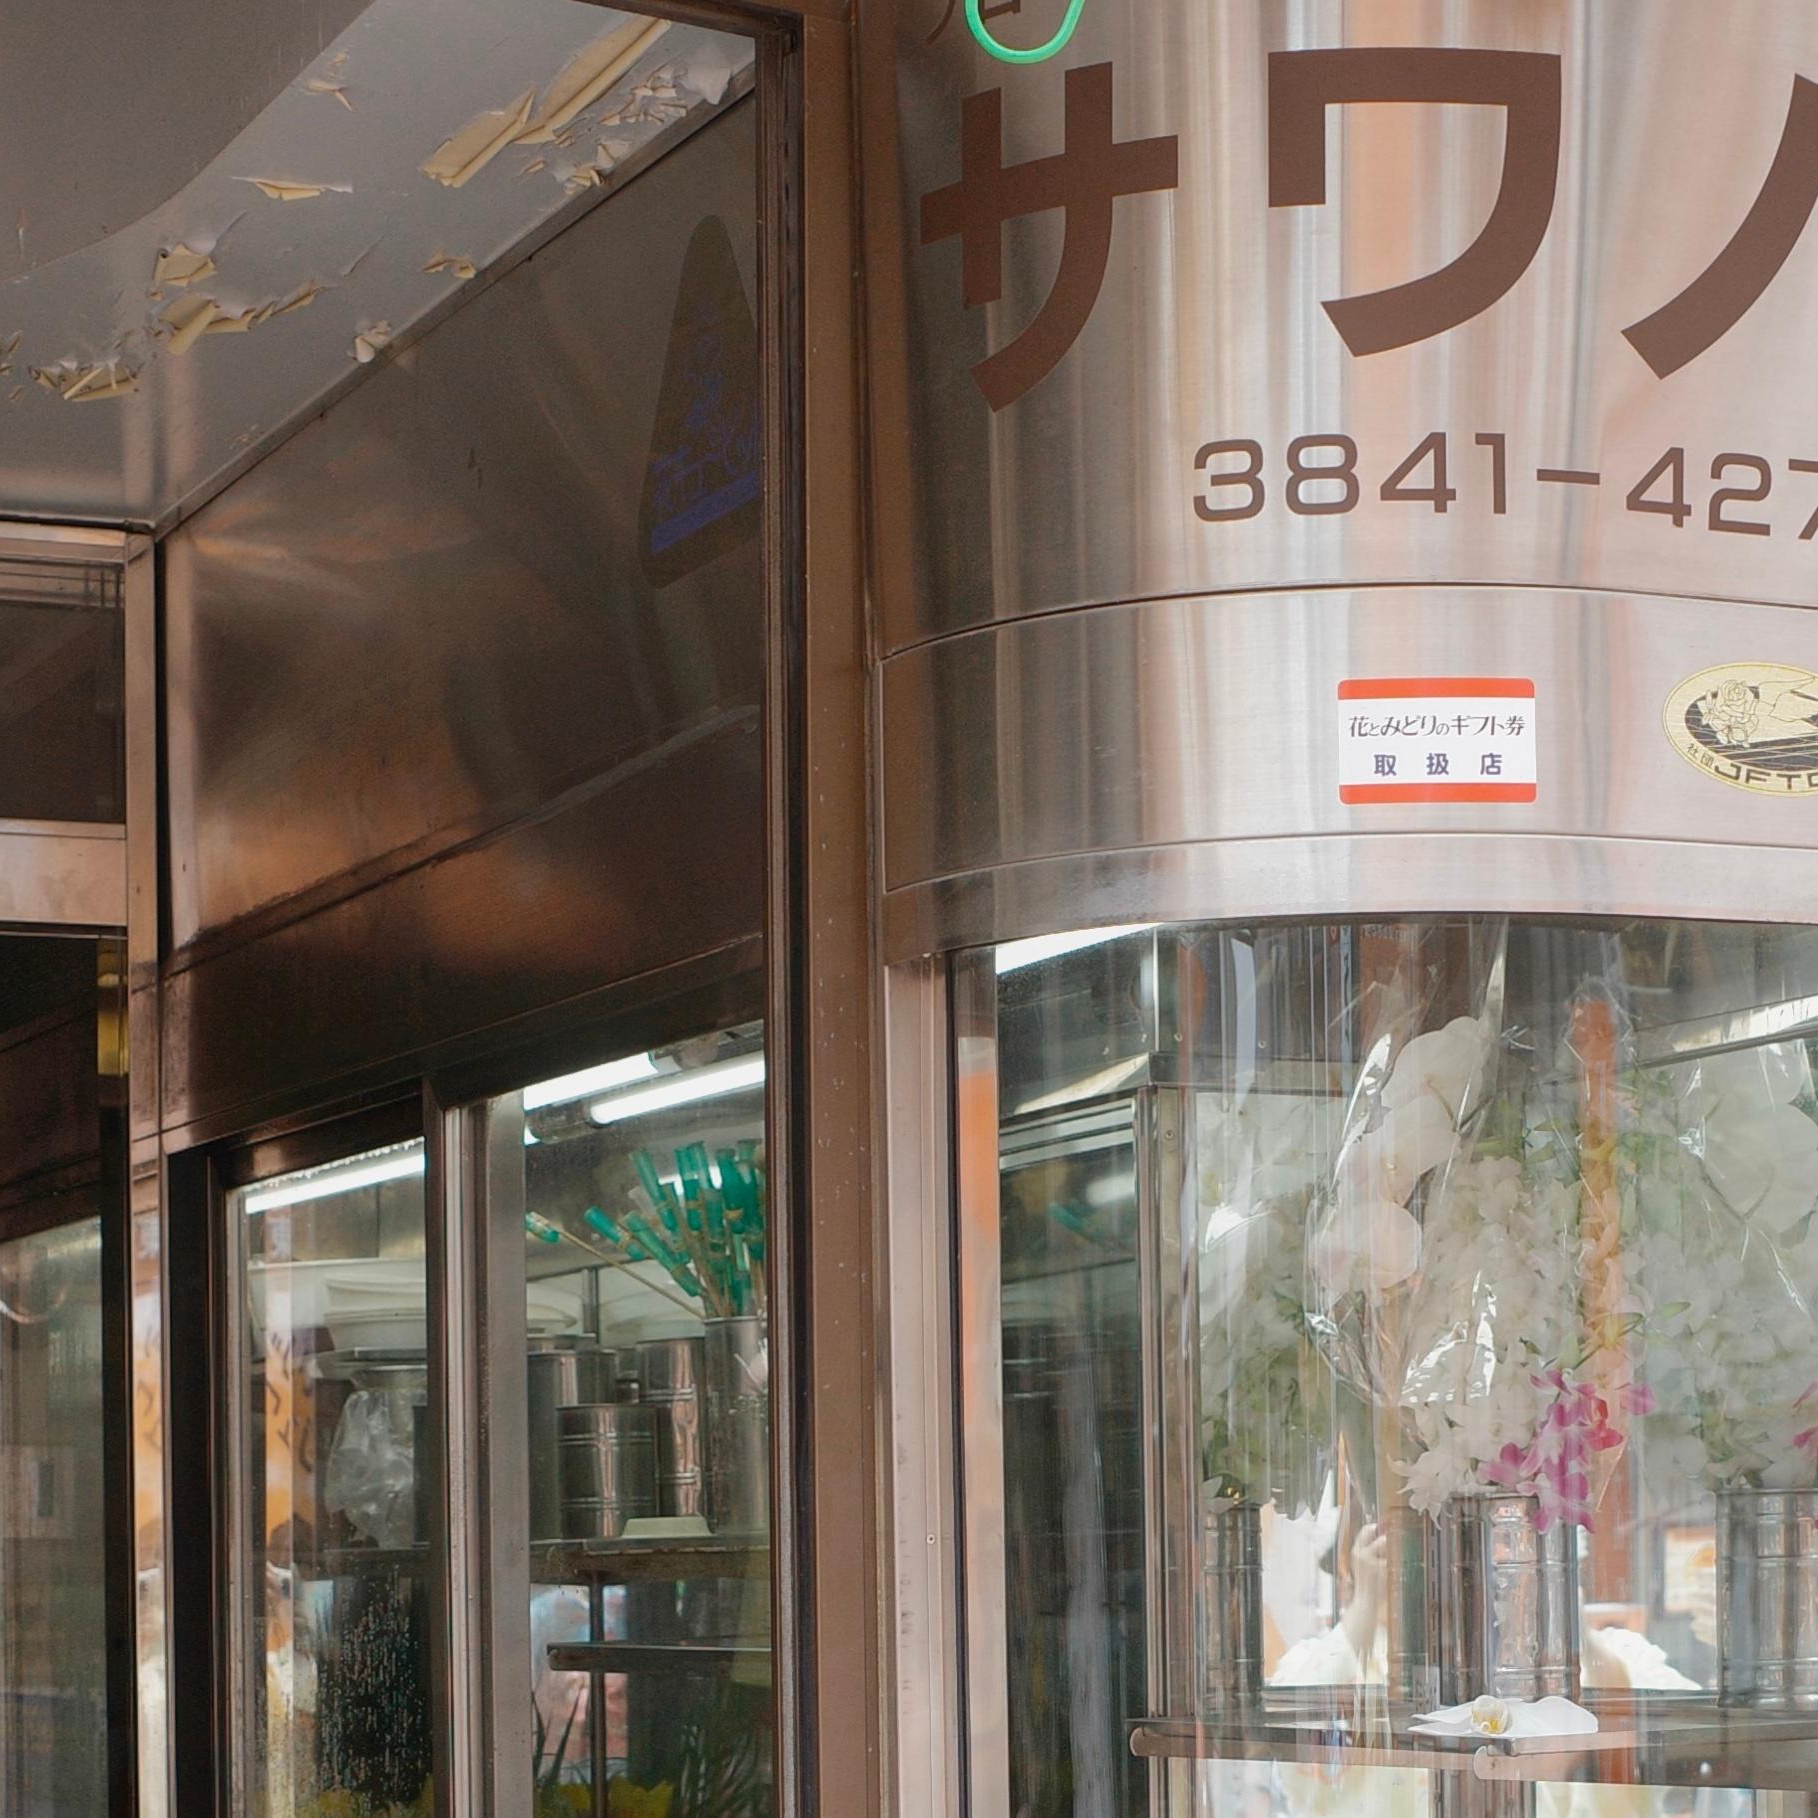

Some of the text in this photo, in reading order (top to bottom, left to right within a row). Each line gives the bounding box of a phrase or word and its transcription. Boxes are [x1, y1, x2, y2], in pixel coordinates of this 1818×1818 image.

[1348, 715, 1526, 738] 花とみどりのギフト券
[1374, 753, 1502, 776] 取扱店
